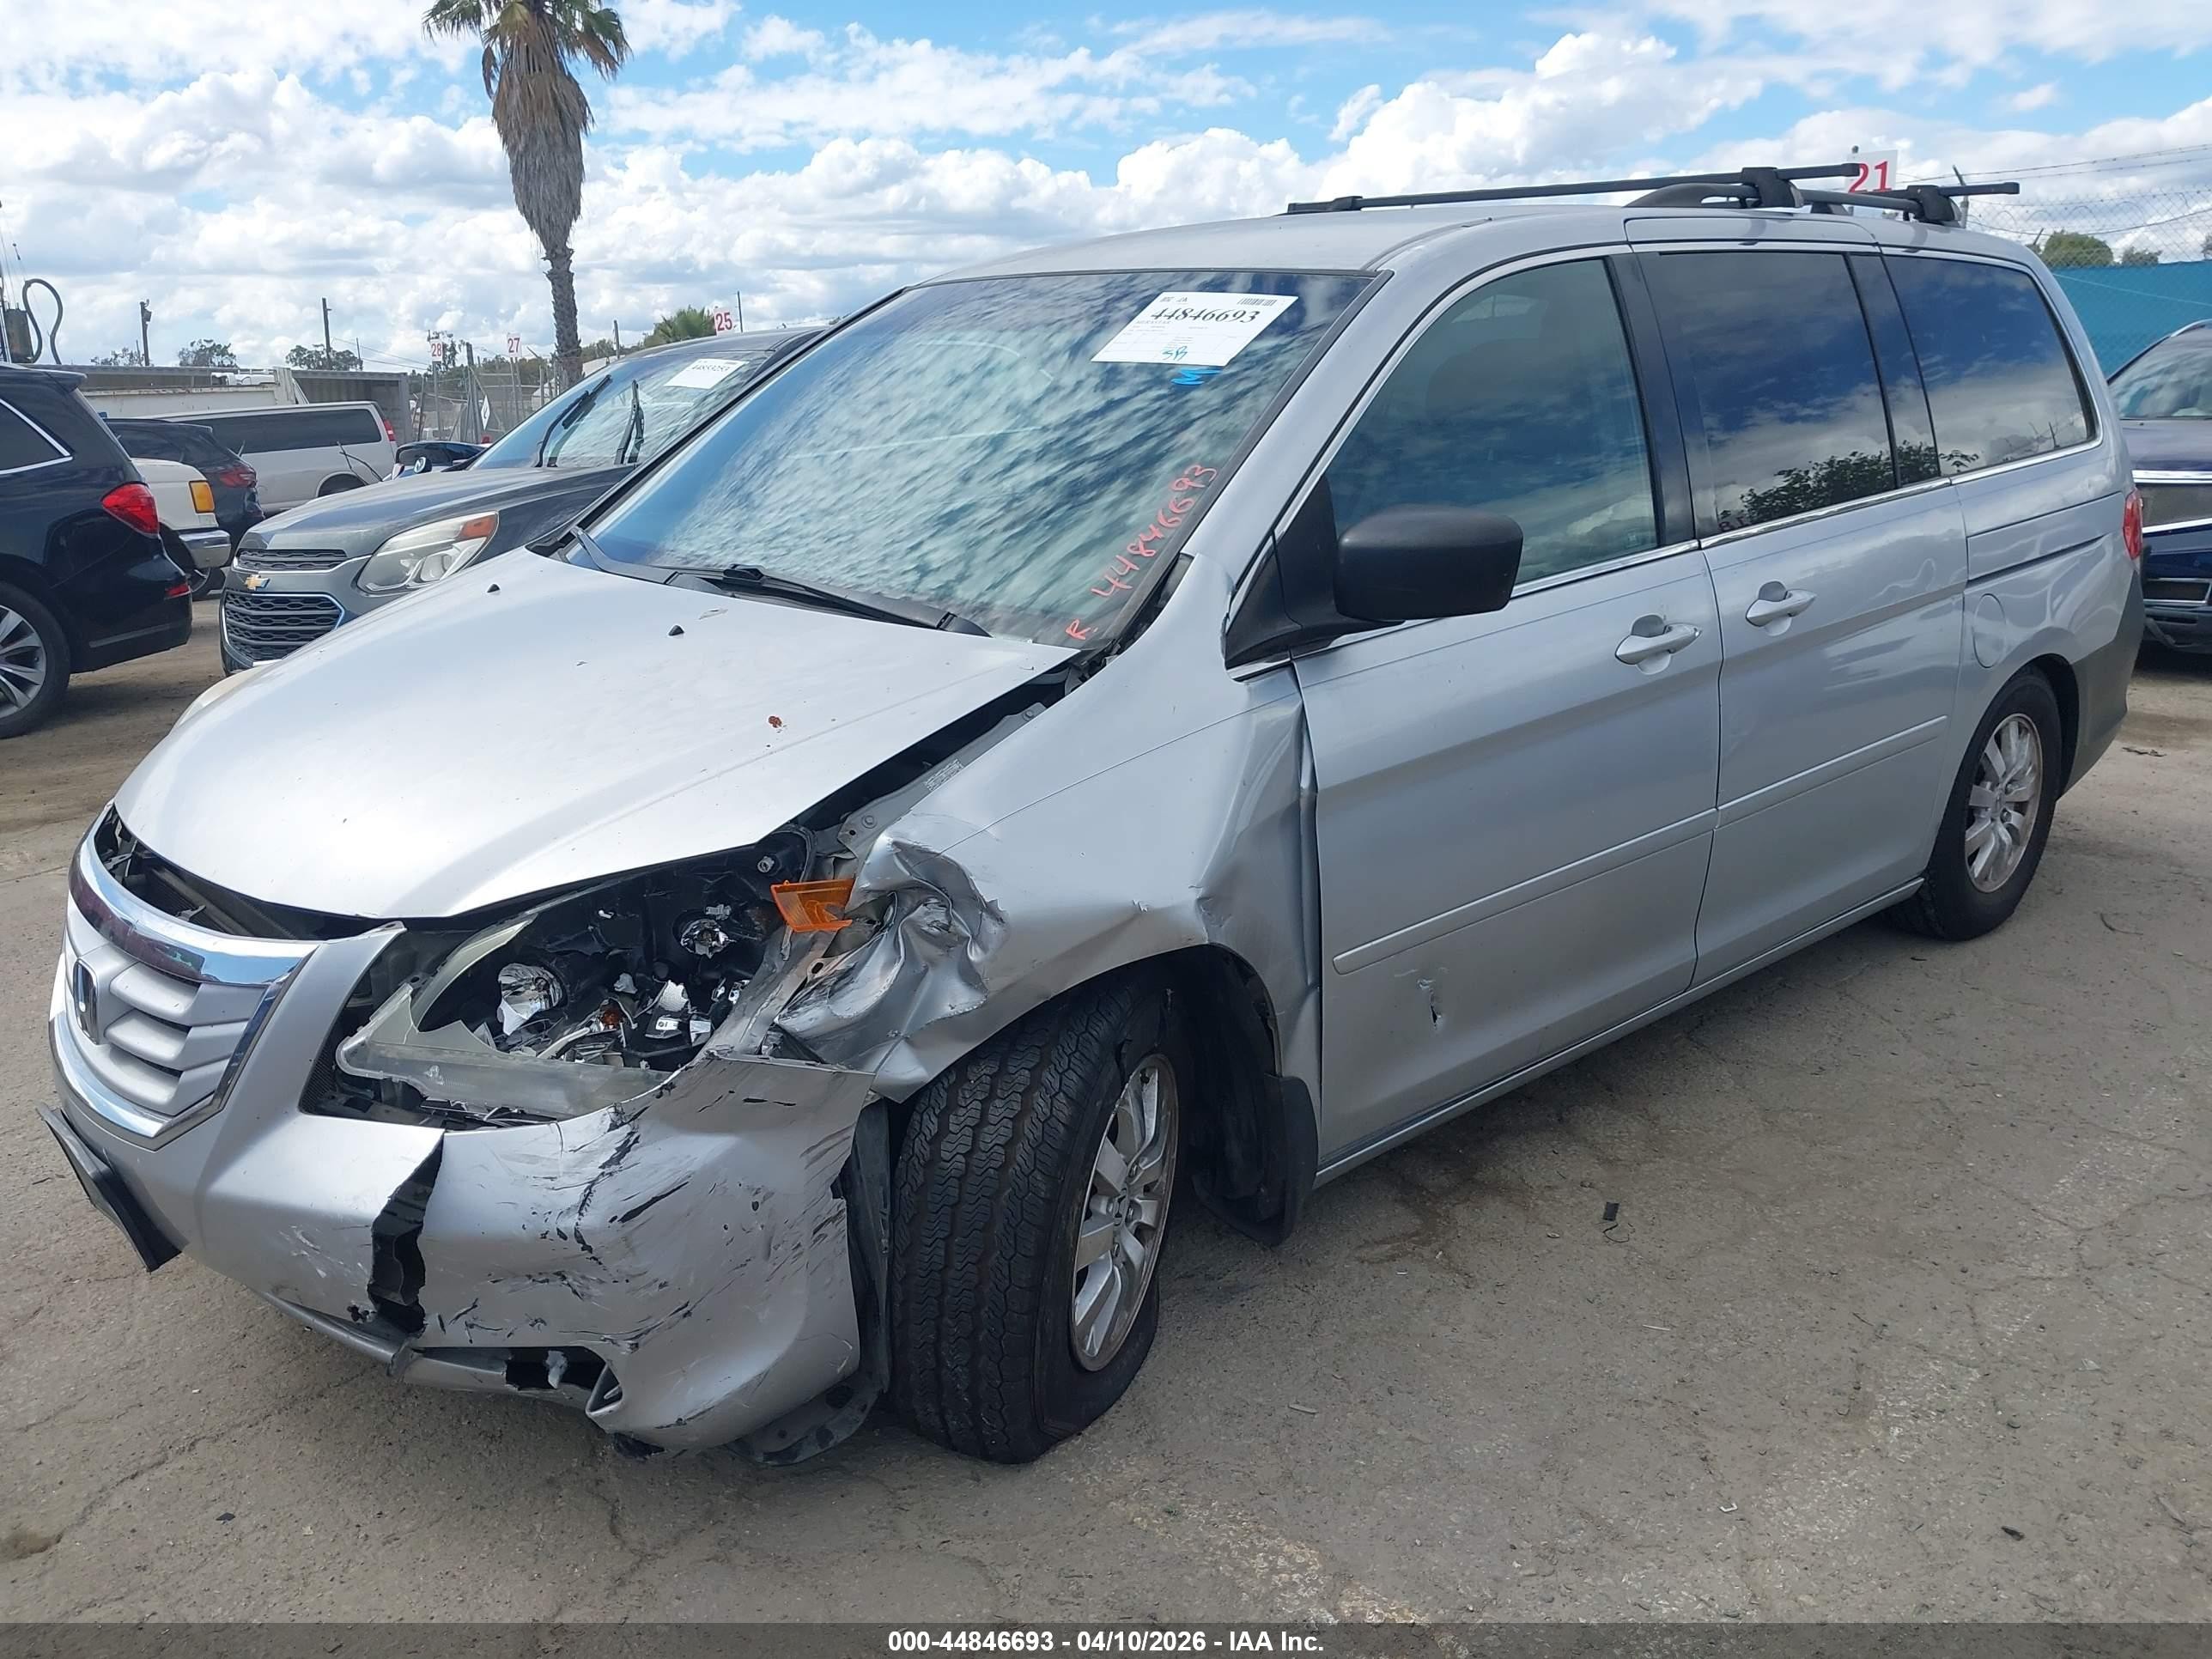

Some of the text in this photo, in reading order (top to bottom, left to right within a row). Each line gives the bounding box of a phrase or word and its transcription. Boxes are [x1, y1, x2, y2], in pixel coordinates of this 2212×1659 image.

[1848, 161, 1893, 193] 21
[715, 312, 732, 331] 25
[1150, 307, 1261, 324] 44846693
[431, 343, 442, 357] 28
[507, 337, 520, 353] 27
[1091, 464, 1218, 597] 44846693
